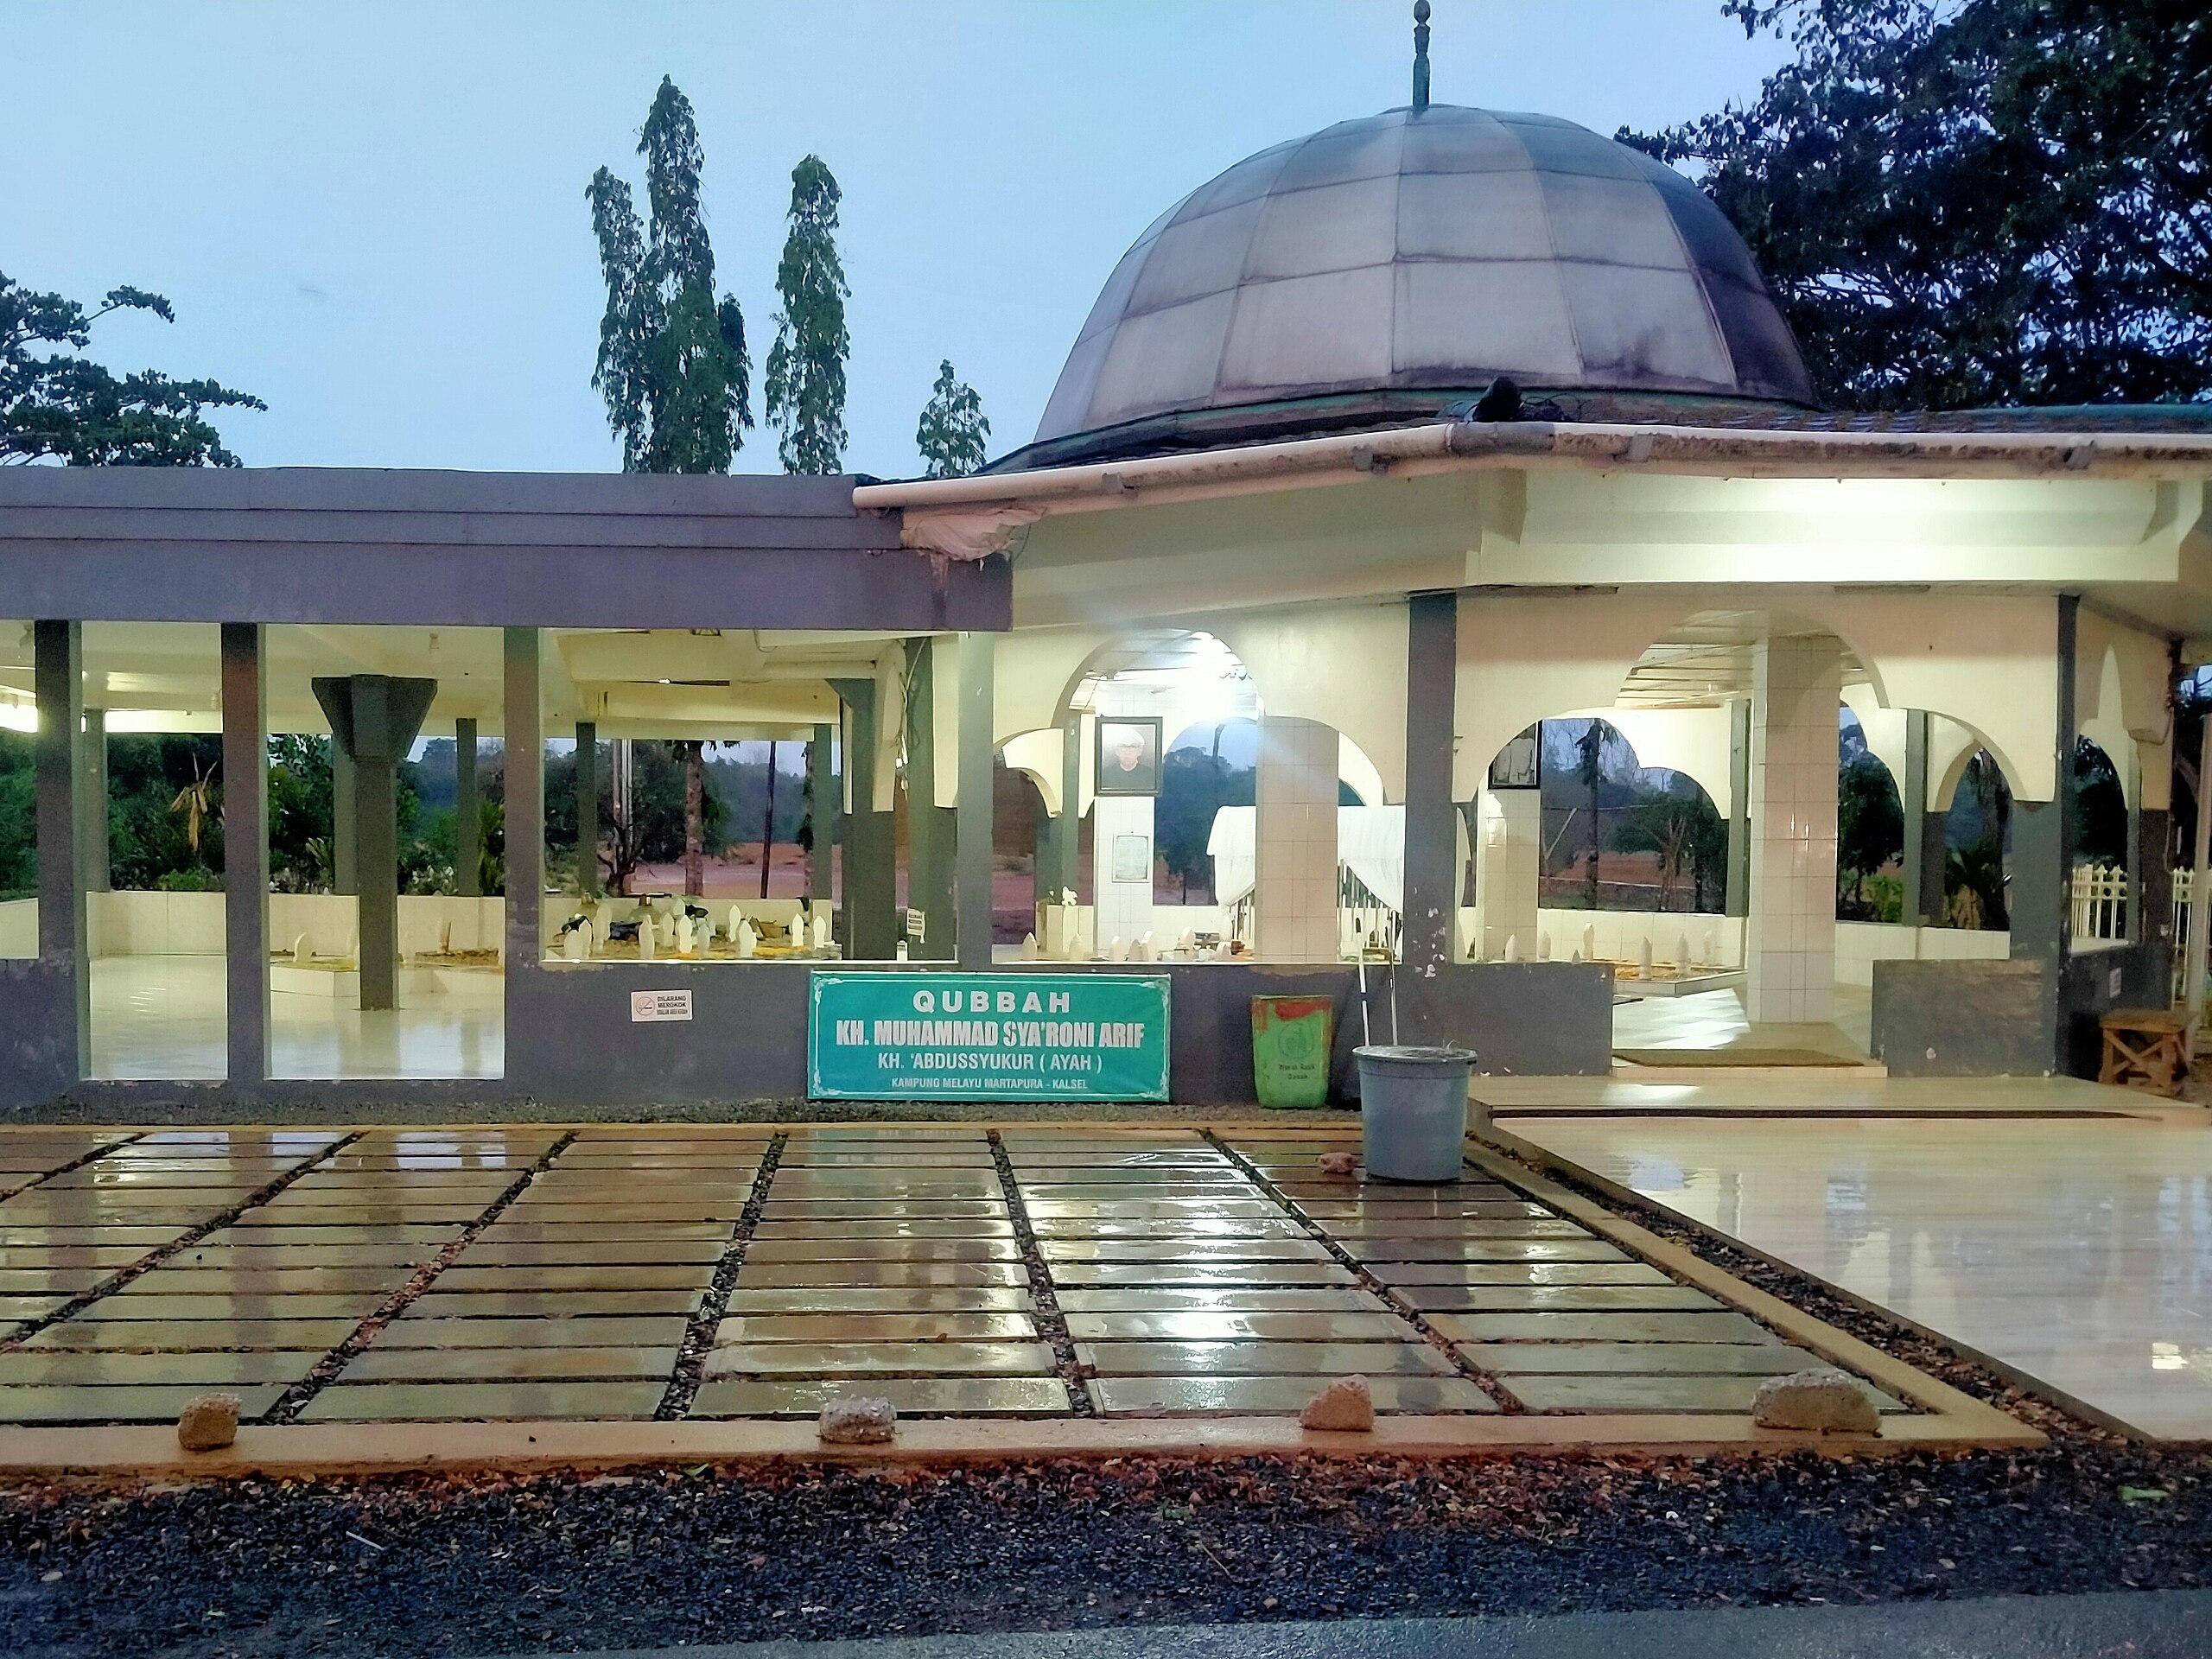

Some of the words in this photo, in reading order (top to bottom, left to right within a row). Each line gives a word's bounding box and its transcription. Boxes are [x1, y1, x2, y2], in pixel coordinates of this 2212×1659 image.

[912, 989, 1070, 1014] QUBBAH
[836, 1020, 870, 1046] KH.
[874, 1020, 999, 1047] MUHAMMAD
[1002, 1021, 1095, 1048] SYA'RONI
[1098, 1022, 1146, 1048] ARIF
[878, 1052, 905, 1070] KH.
[892, 1077, 940, 1089] KAMPUNG
[942, 1077, 982, 1089] MELAYU
[984, 1078, 1044, 1089] MARTAPURA
[1052, 1078, 1089, 1090] KALSEL
